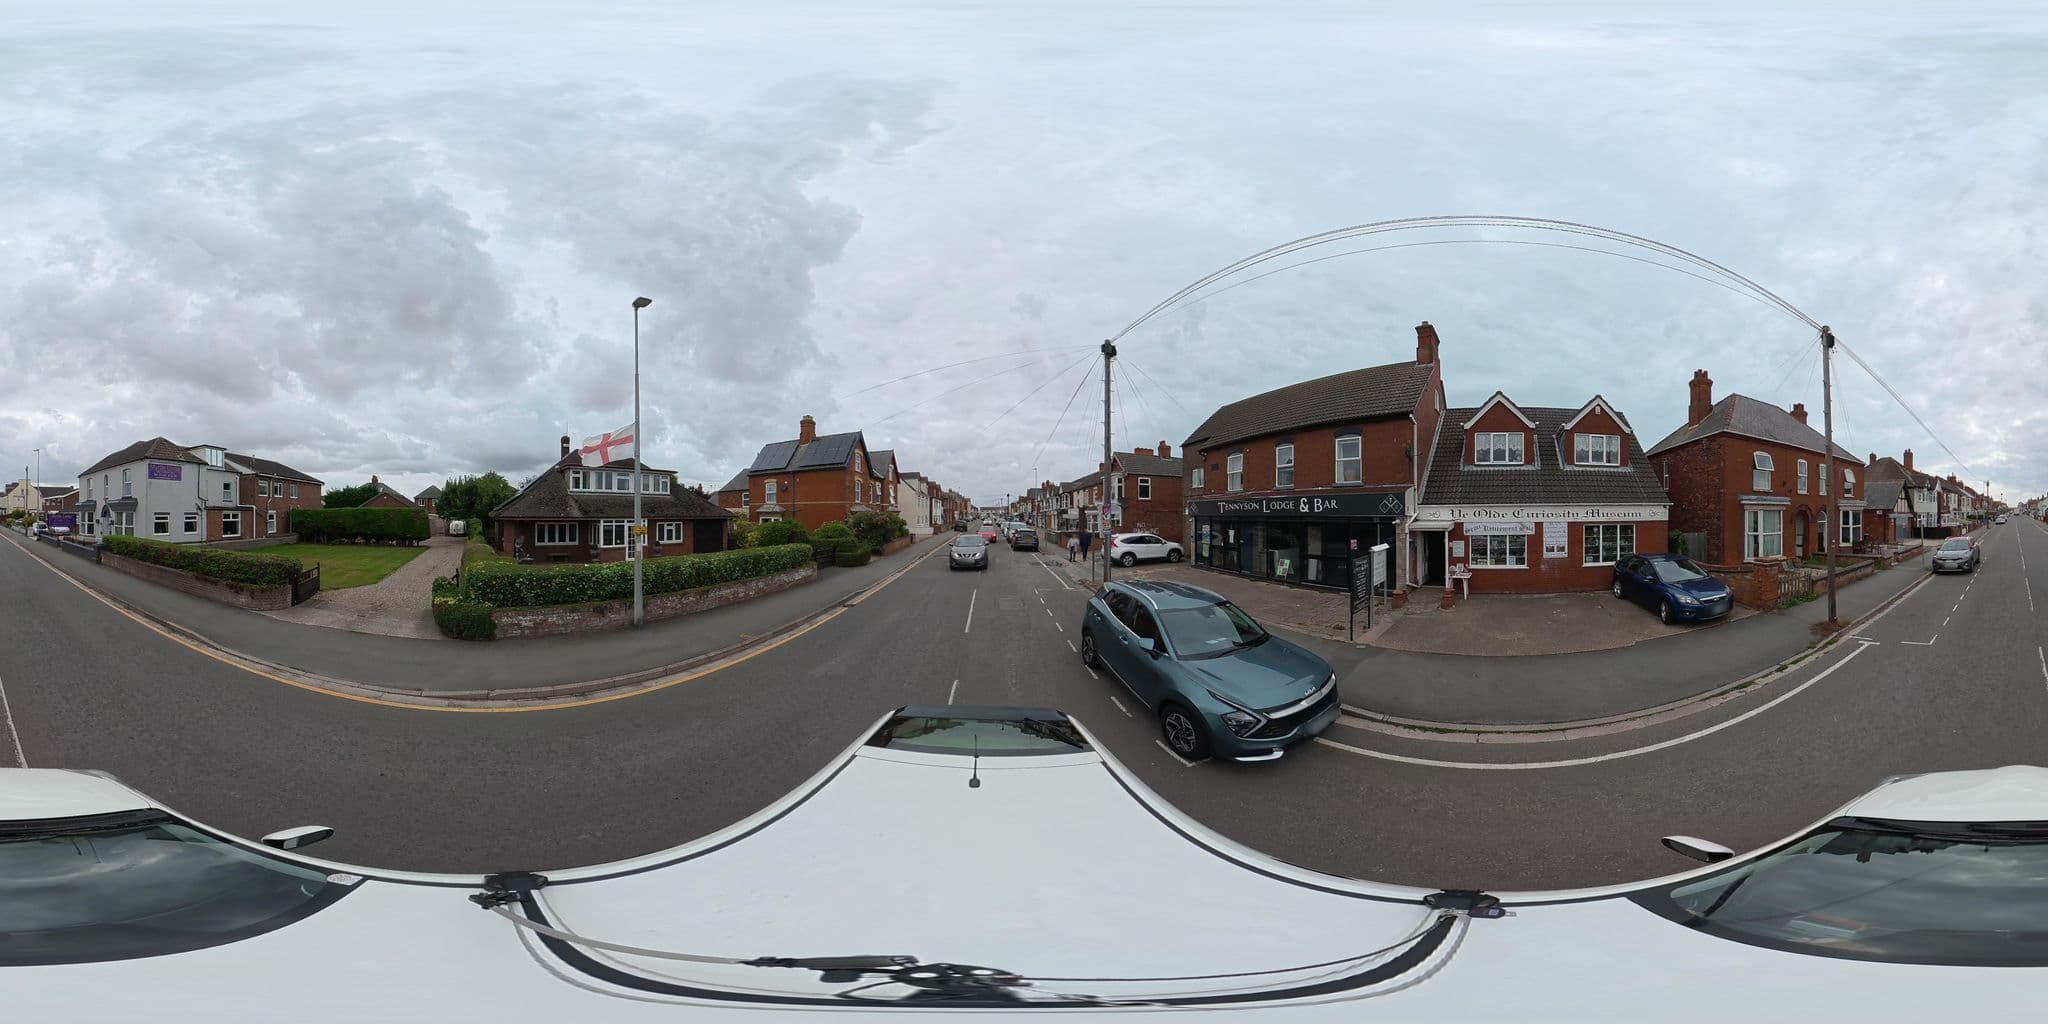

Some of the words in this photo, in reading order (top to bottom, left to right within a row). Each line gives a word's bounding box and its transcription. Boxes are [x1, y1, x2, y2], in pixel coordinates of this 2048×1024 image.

[1218, 501, 1260, 513] TENNYSON
[1263, 500, 1295, 513] LODGE
[1299, 497, 1310, 513] &
[1314, 498, 1338, 512] BAR
[1449, 508, 1469, 520] Ye
[1473, 508, 1508, 519] Olde
[1512, 508, 1579, 520] Curiosity
[1581, 508, 1641, 519] Museum
